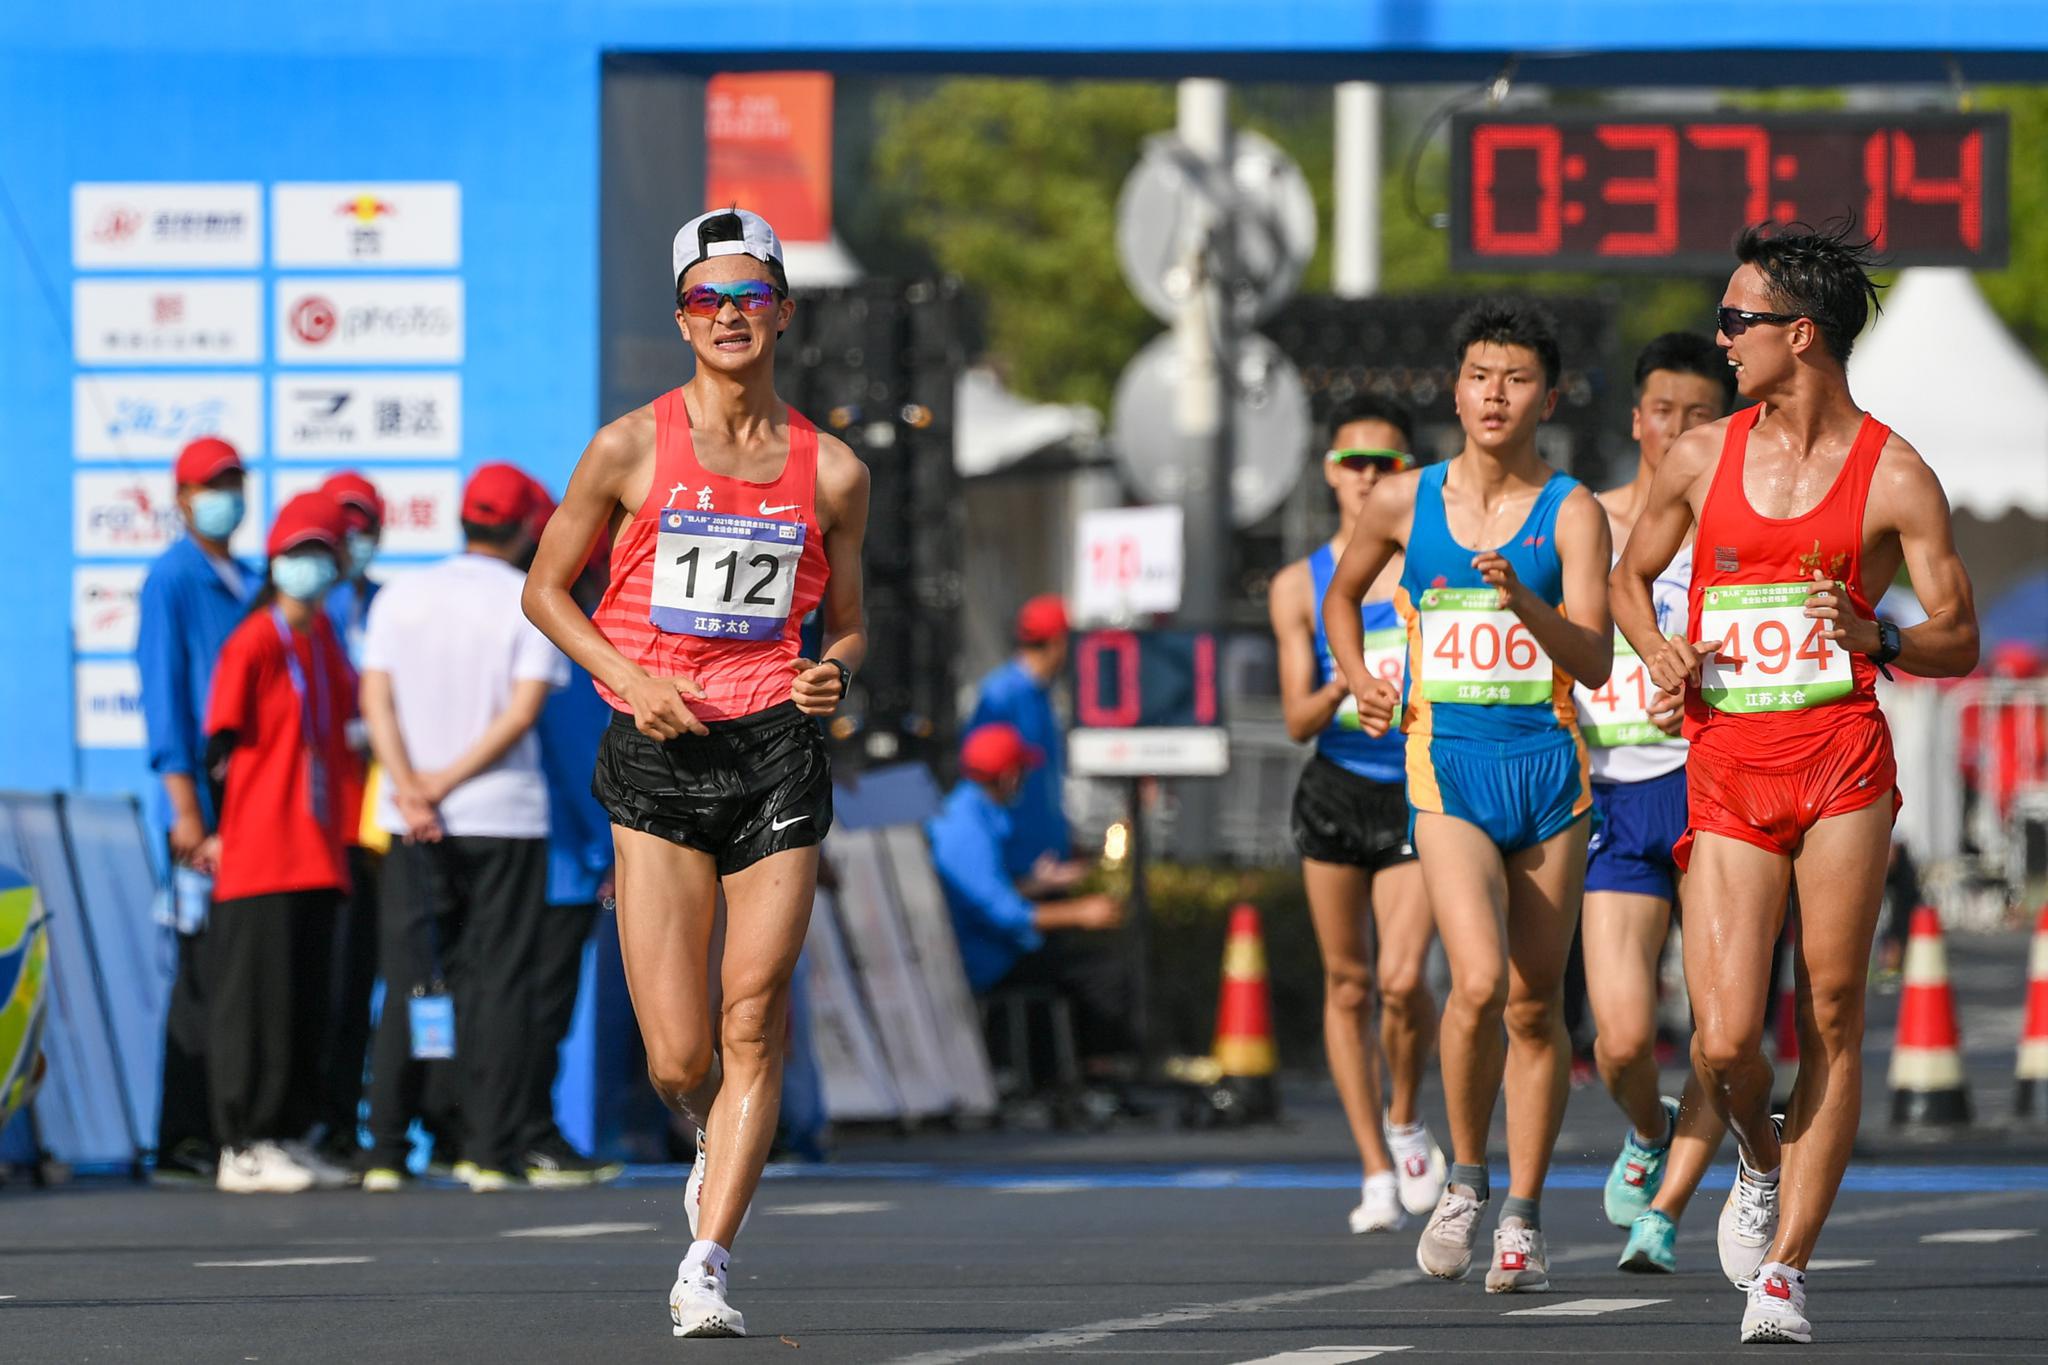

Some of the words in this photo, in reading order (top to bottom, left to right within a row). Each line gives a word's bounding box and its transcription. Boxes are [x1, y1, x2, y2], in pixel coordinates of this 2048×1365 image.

[1471, 123, 1983, 256] 0:37:14
[666, 482, 714, 511] 广东
[675, 546, 780, 606] 112
[693, 616, 751, 634] 江苏·太仓
[1433, 622, 1538, 671] 406
[1714, 616, 1834, 676] 494
[1745, 690, 1807, 706] 江苏·太仓
